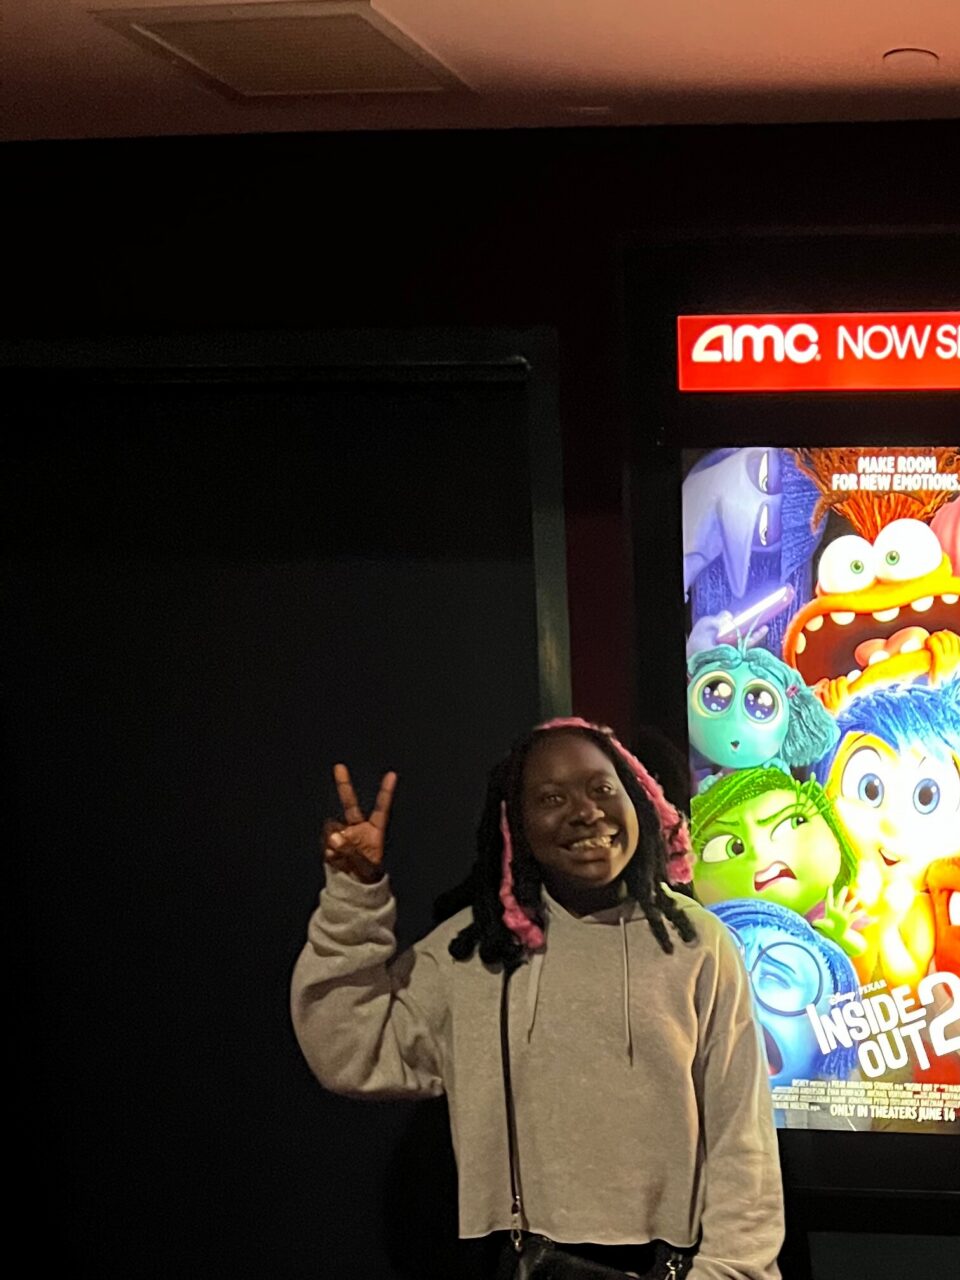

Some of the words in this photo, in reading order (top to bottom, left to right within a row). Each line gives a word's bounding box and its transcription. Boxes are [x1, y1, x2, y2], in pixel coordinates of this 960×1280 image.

[837, 324, 931, 360] NOW
[857, 456, 896, 473] MAKE
[897, 456, 937, 473] ROOM
[832, 473, 858, 491] FOR
[859, 473, 891, 491] NEW
[806, 984, 927, 1055] INSIDE
[857, 1019, 931, 1078] OUT
[829, 1103, 856, 1117] ONLY
[857, 1104, 868, 1118] IN
[869, 1105, 917, 1120] THEATERS
[917, 1106, 942, 1122] JUNE
